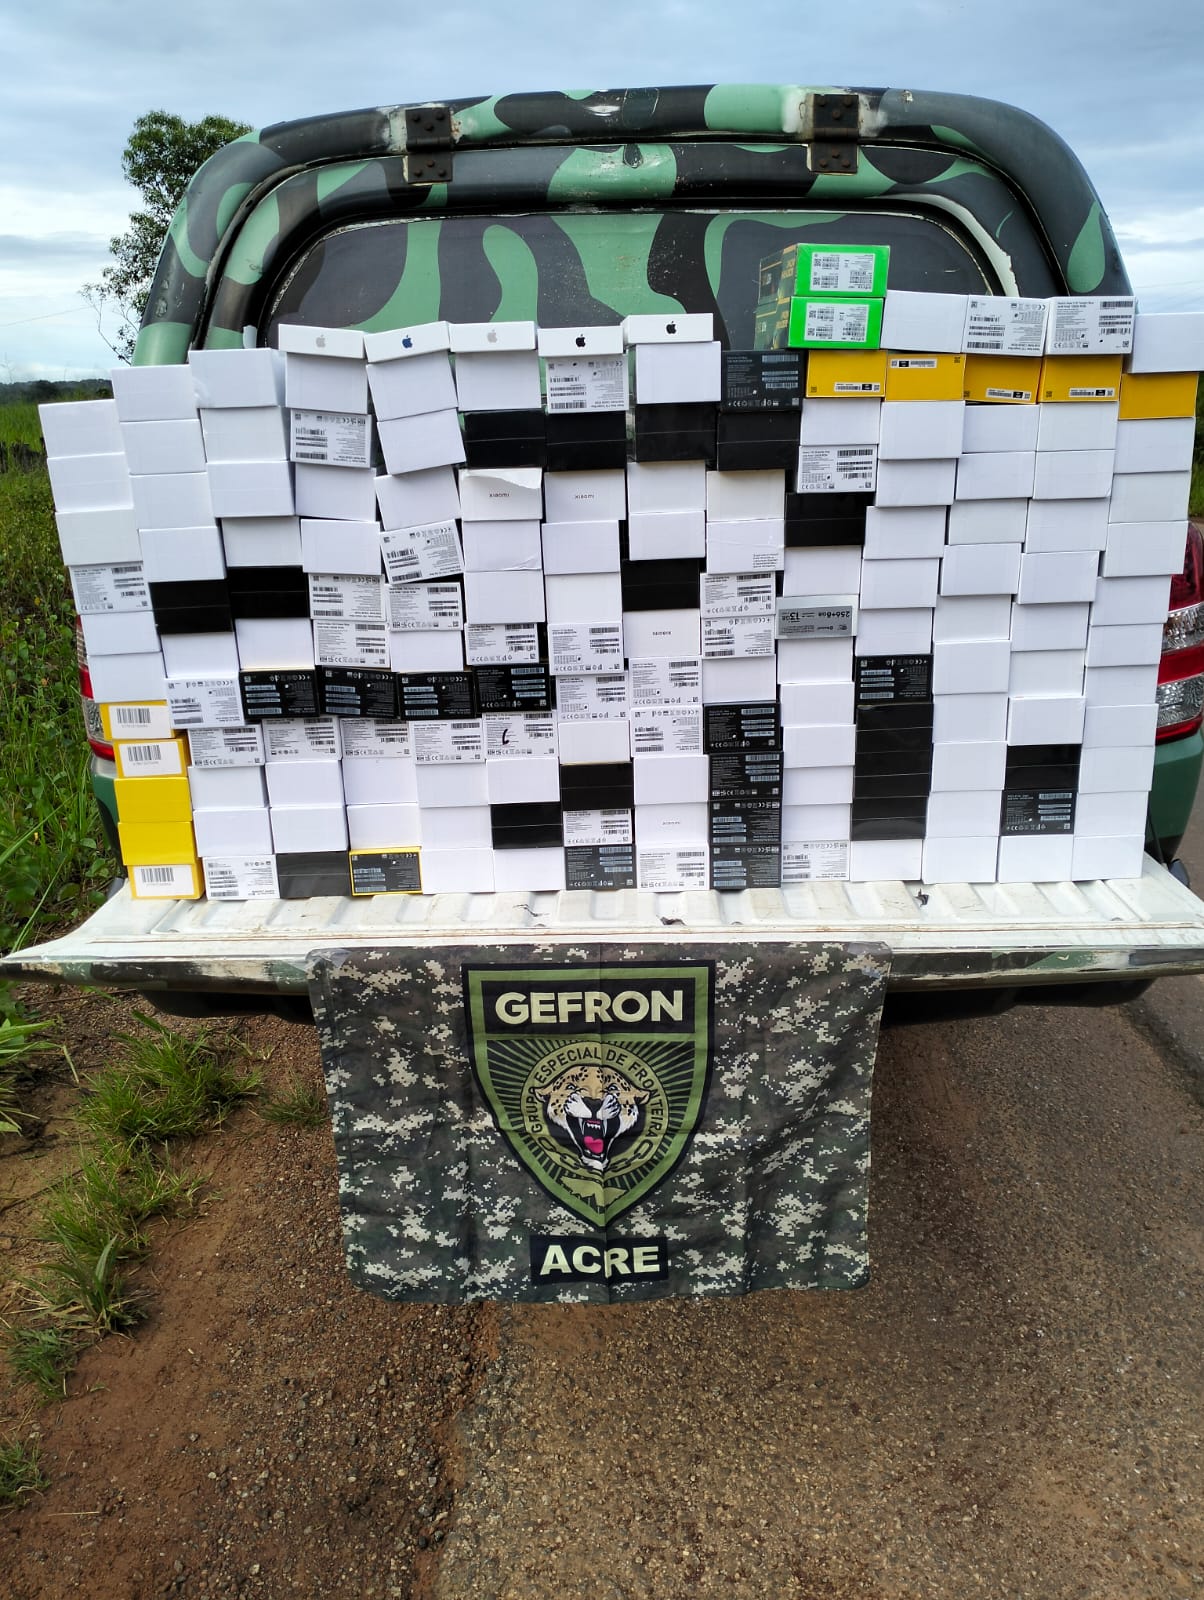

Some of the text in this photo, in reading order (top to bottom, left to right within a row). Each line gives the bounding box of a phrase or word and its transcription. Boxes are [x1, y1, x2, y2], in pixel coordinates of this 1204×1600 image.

[495, 990, 683, 1025] GEFRON
[526, 1046, 664, 1138] GRUPO ESPECIAL DE FRONTEIRA
[539, 1244, 660, 1279] ACRE
